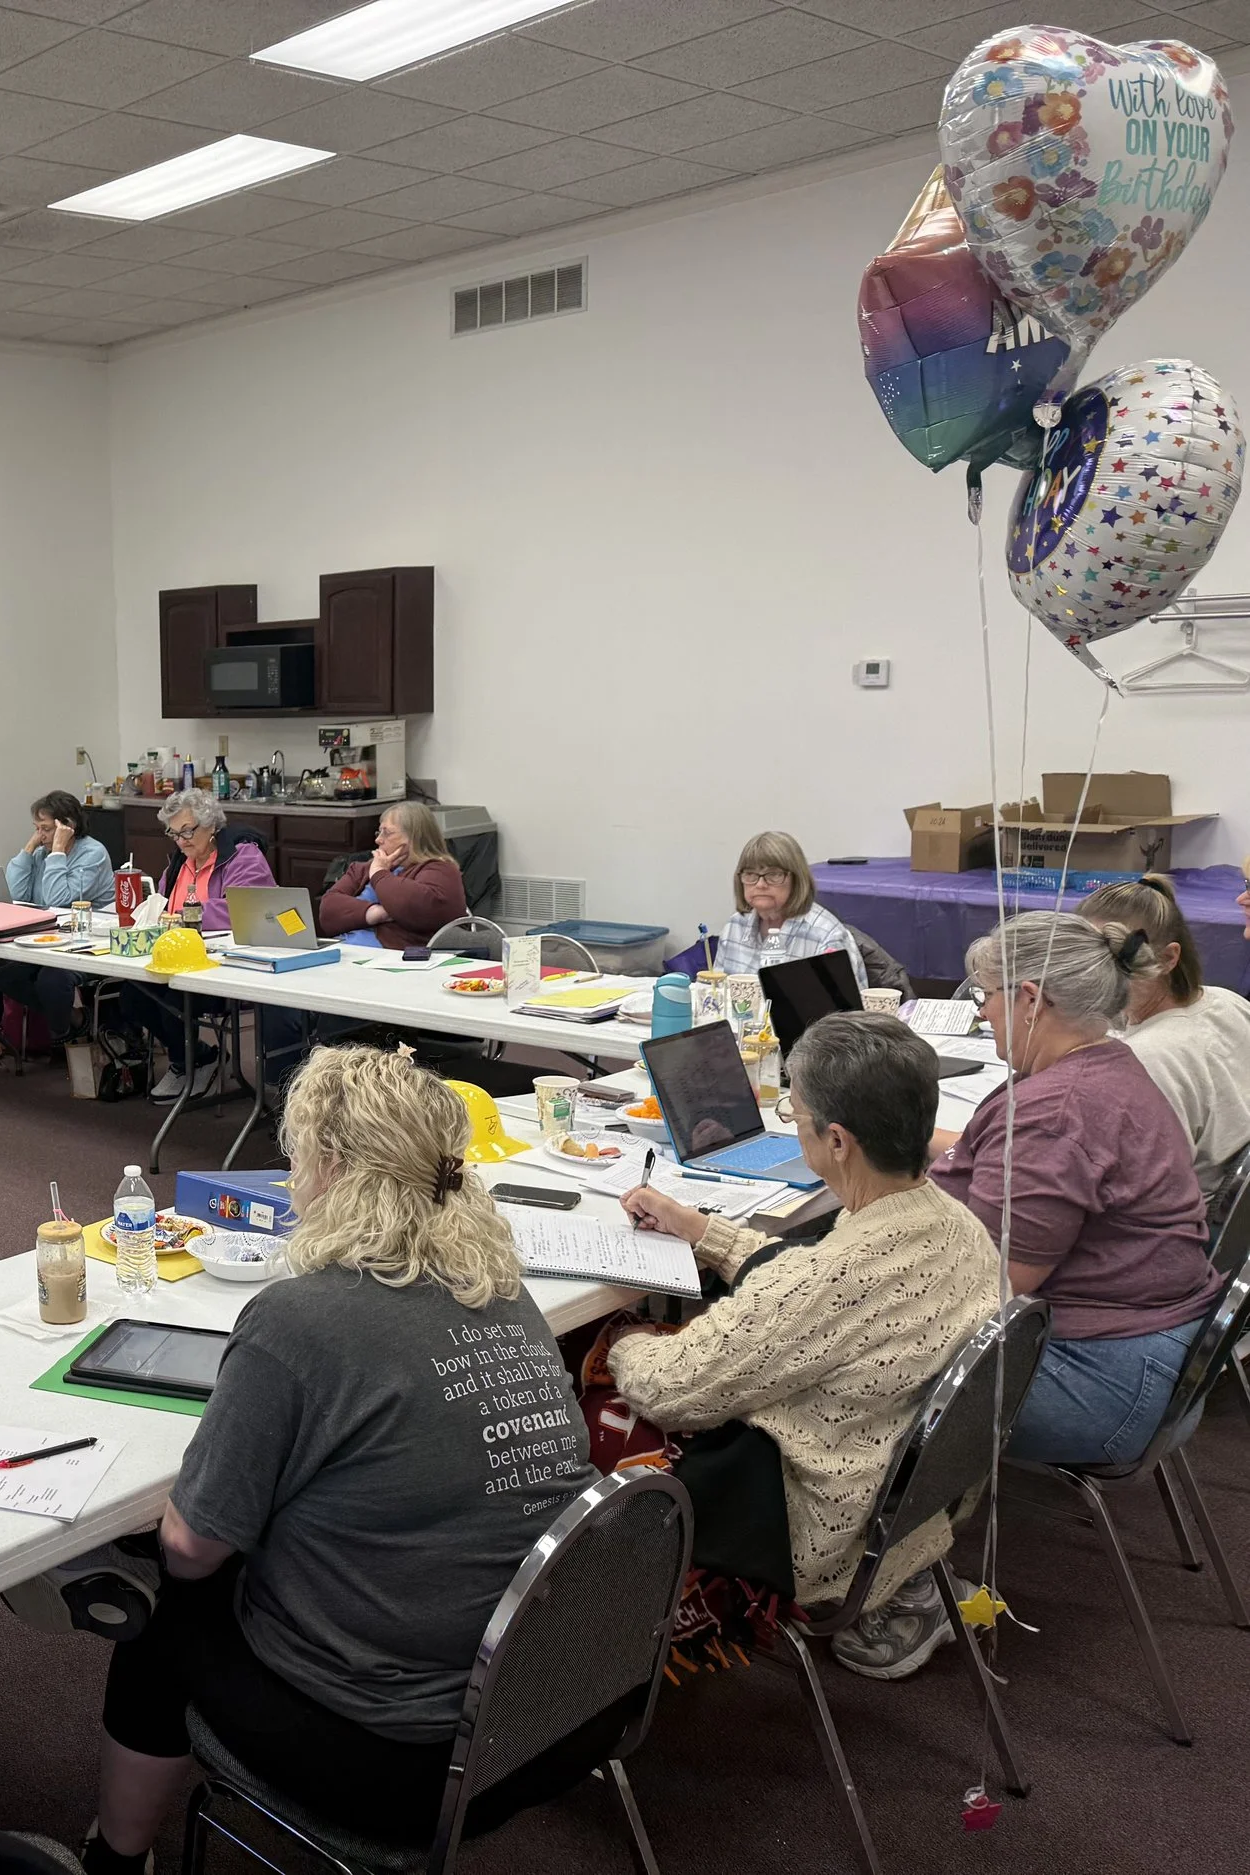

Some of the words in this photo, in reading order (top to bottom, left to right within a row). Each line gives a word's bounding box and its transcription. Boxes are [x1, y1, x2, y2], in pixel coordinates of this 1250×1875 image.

[1108, 72, 1171, 118] With
[1175, 82, 1217, 121] love
[1125, 118, 1157, 156] ON
[1163, 120, 1211, 163] YOUR
[1097, 157, 1212, 216] Birthday
[447, 1328, 460, 1346] I
[462, 1325, 482, 1343] do
[484, 1323, 507, 1339] set
[505, 1323, 527, 1340] my
[431, 1353, 471, 1376] bow
[474, 1348, 494, 1365] in
[493, 1343, 519, 1361] the
[443, 1373, 479, 1402] and
[480, 1371, 496, 1389] it
[496, 1361, 533, 1385] shall
[530, 1361, 550, 1378] be
[478, 1401, 492, 1416] a
[493, 1389, 537, 1411] token
[538, 1382, 554, 1400] of
[553, 1385, 563, 1399] a
[487, 1439, 558, 1469] between
[560, 1435, 577, 1451] me
[485, 1468, 521, 1495] and
[525, 1464, 552, 1484] the
[523, 1495, 560, 1516] Genesis
